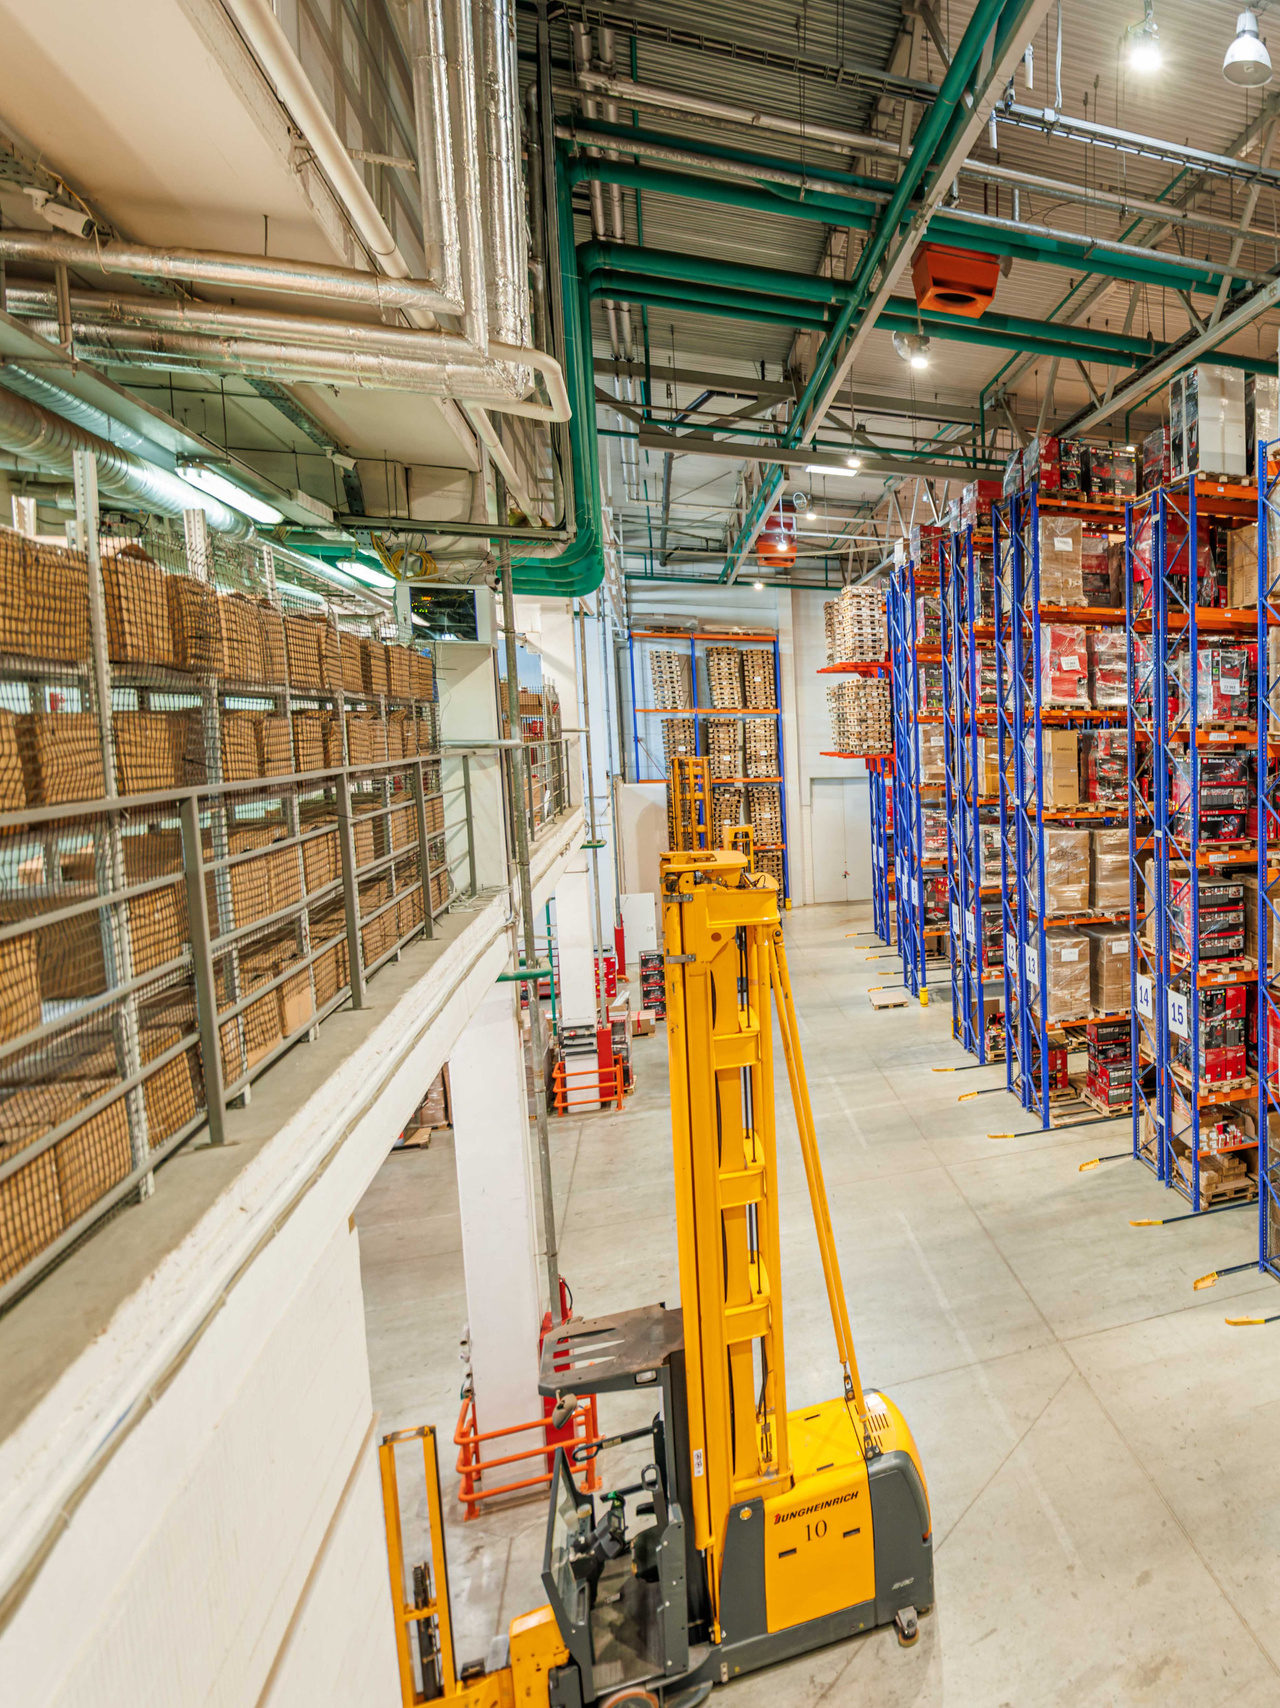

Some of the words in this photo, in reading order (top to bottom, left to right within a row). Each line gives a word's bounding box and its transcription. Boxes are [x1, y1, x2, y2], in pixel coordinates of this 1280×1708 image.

[967, 920, 973, 936] 11
[1008, 943, 1015, 962] 12
[1028, 955, 1036, 975] 13
[1139, 985, 1149, 1007] 14
[1171, 1002, 1184, 1025] 15
[773, 1490, 859, 1526] JUNGHEINRICH
[806, 1519, 828, 1542] 10
